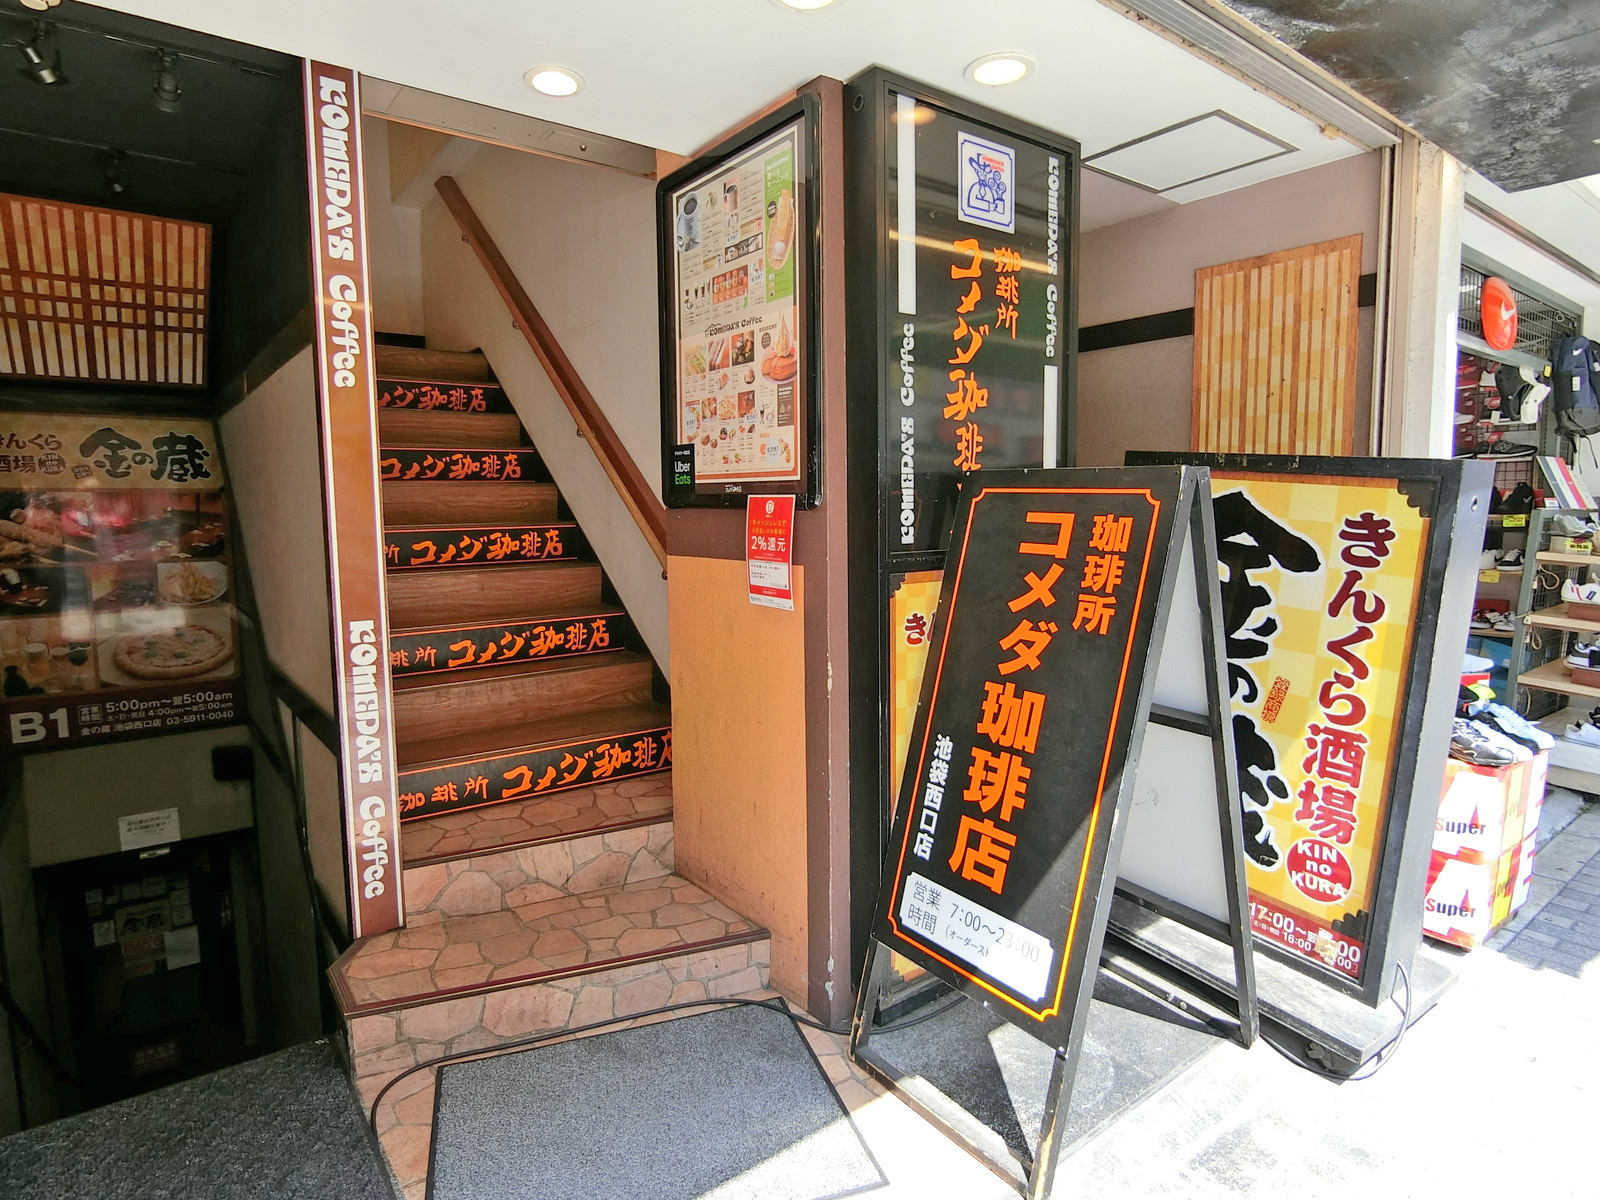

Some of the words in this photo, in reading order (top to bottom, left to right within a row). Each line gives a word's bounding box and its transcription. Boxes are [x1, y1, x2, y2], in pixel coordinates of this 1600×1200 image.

[320, 76, 354, 262] KOMEDA'S
[1047, 156, 1059, 276] KOMEDA'S
[993, 246, 1022, 340] 珈琲所
[1046, 284, 1058, 358] Coffee
[329, 274, 360, 388] Coffee
[943, 238, 990, 476] コメダ珈琲
[900, 323, 915, 407] Coffee
[0, 432, 63, 451] んくら
[79, 427, 211, 483] 金の蔵
[674, 461, 691, 472] Uber
[674, 473, 691, 485] Eats
[900, 417, 915, 545] KOMEDA'S
[410, 529, 563, 565] コメダ珈琲店
[751, 535, 786, 552] 2%還元
[1072, 513, 1134, 635] 珈琲所
[448, 618, 610, 667] コメダ珈琲店
[350, 620, 383, 784] KOMEDA'S
[948, 511, 1076, 895] コメダ珈琲店
[1296, 511, 1396, 844] きんくら酒場
[10, 708, 70, 744] B1
[166, 710, 234, 727] 03-5911-0040
[913, 733, 954, 861] 池袋西口店
[360, 795, 388, 899] Coffee
[1296, 842, 1338, 864] KIN
[1305, 860, 1332, 876] no
[914, 879, 942, 911] 営業
[1290, 870, 1348, 898] KURA
[1425, 898, 1476, 919] Super
[907, 903, 937, 936] 時間
